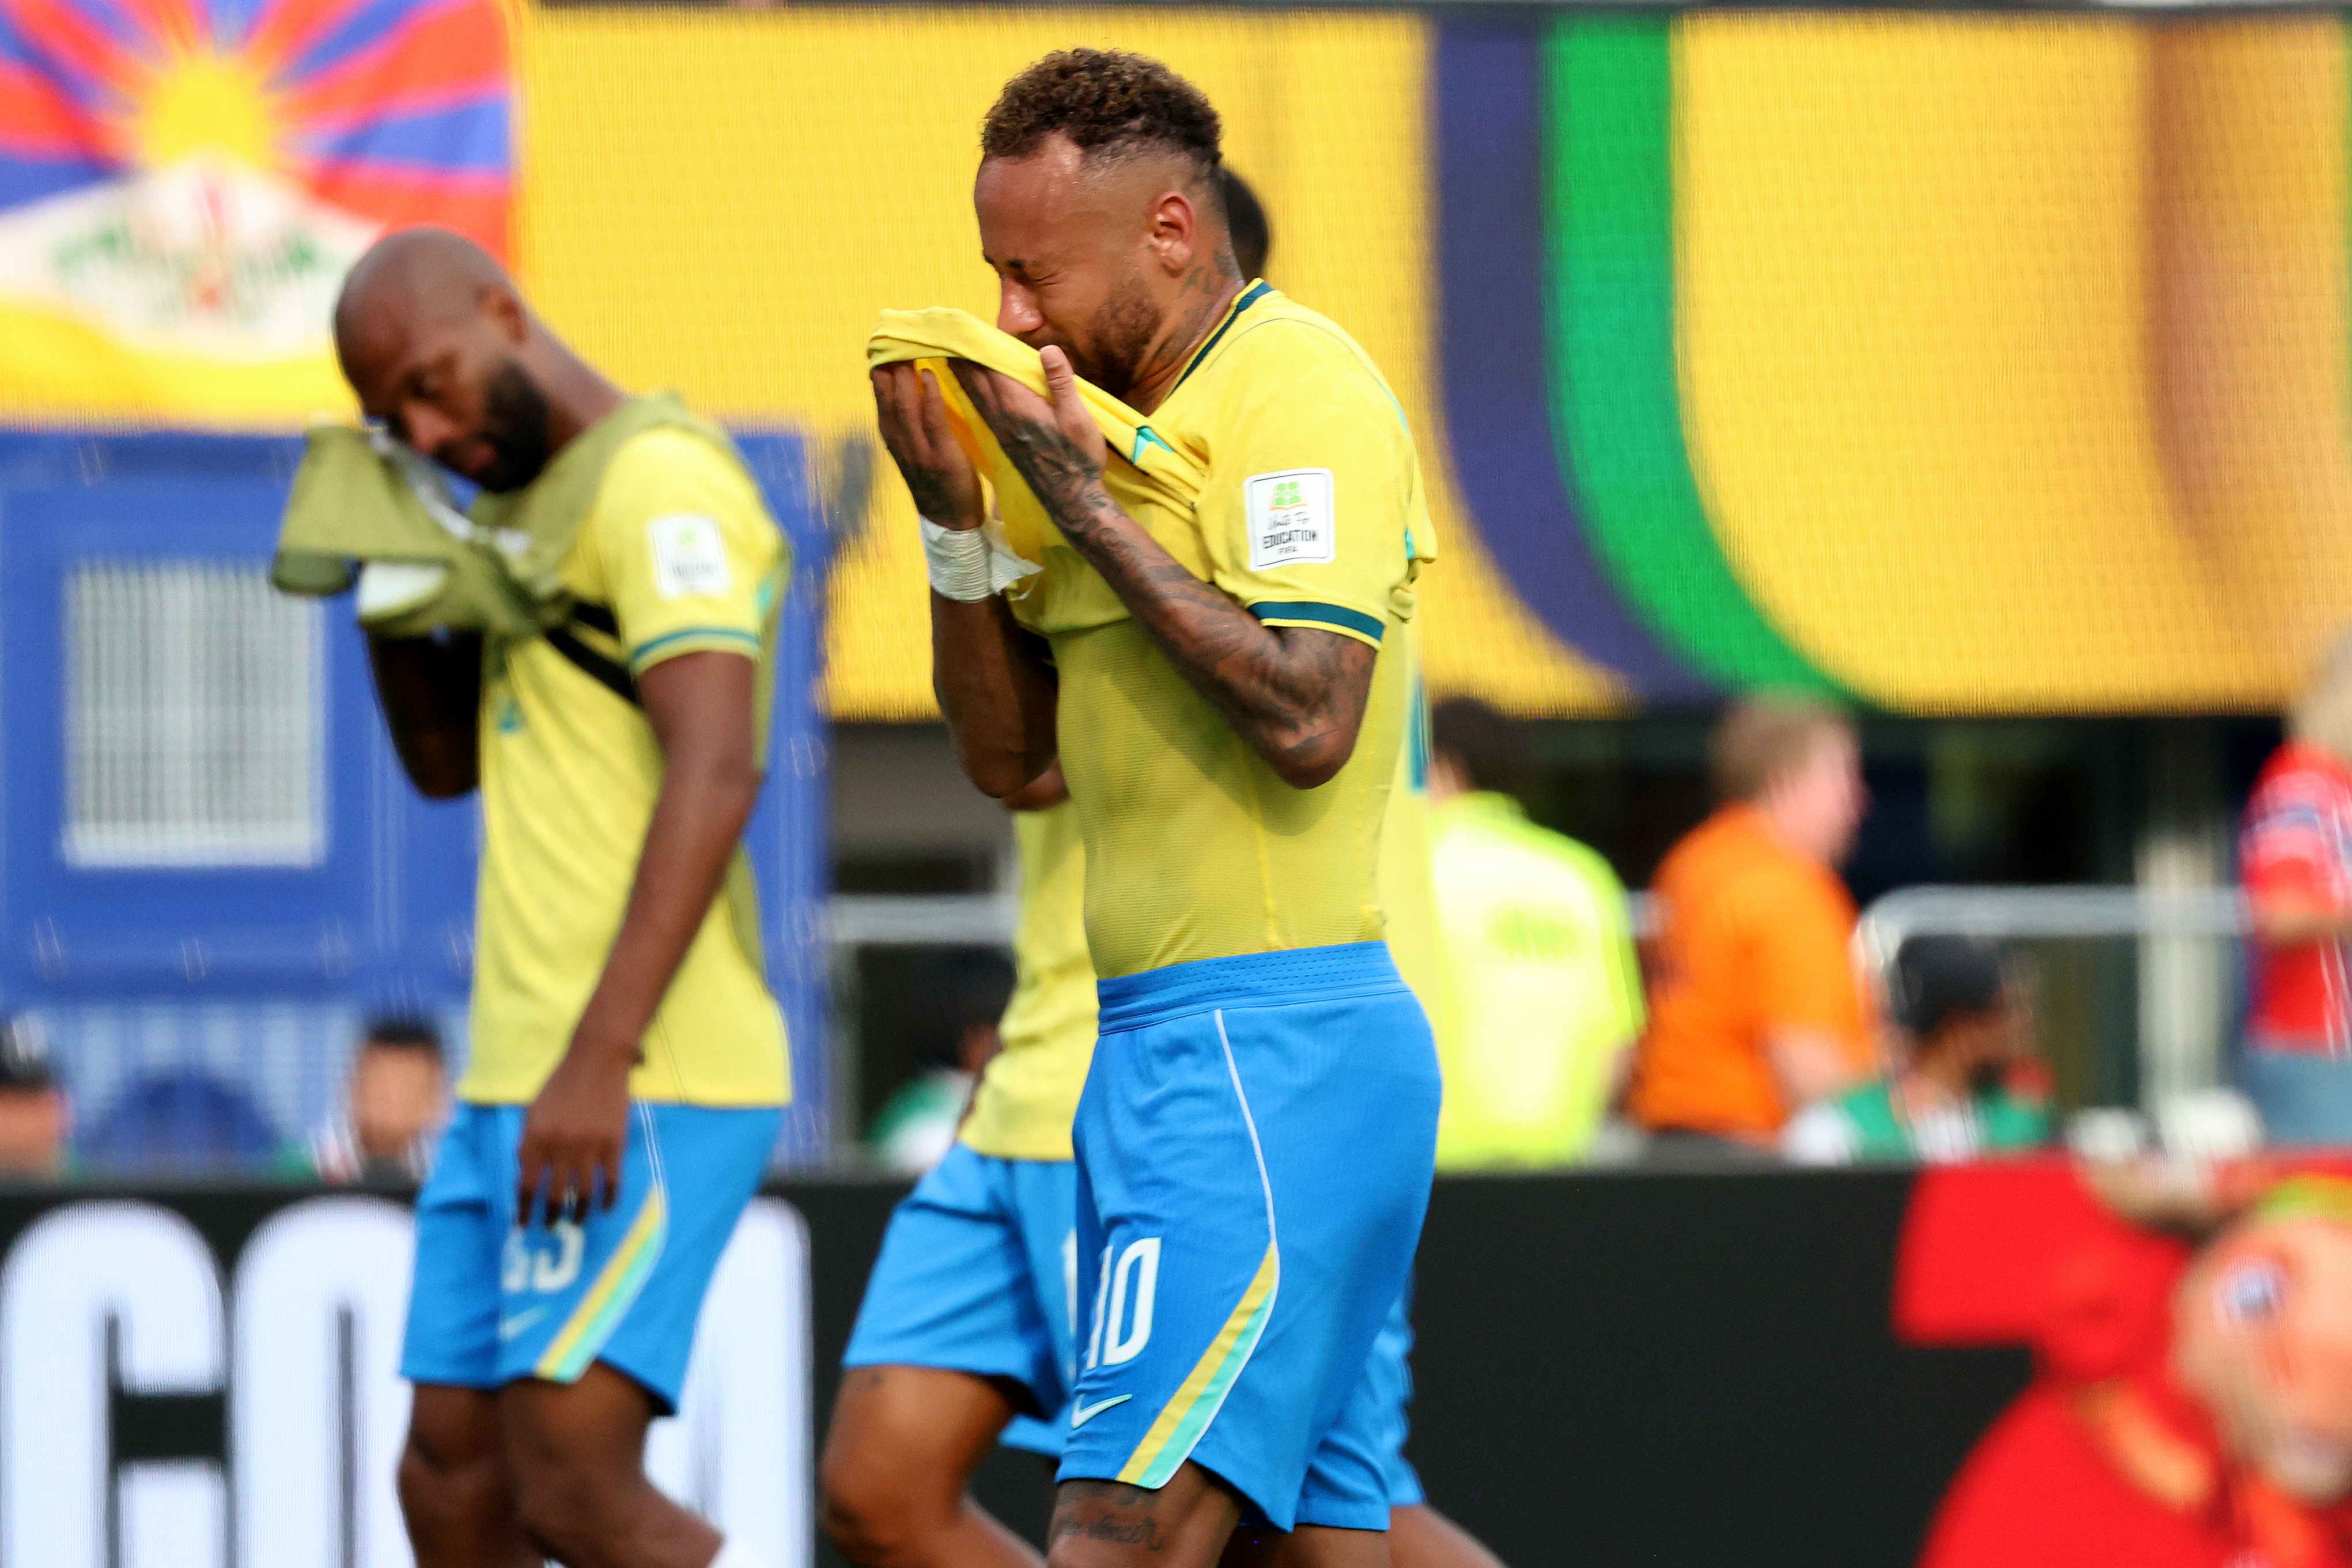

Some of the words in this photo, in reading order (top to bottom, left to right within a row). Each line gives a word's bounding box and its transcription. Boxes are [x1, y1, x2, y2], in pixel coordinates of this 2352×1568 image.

[1262, 529, 1318, 549] EDUCATION
[1277, 546, 1299, 555] FIFA
[1087, 1237, 1162, 1370] 10
